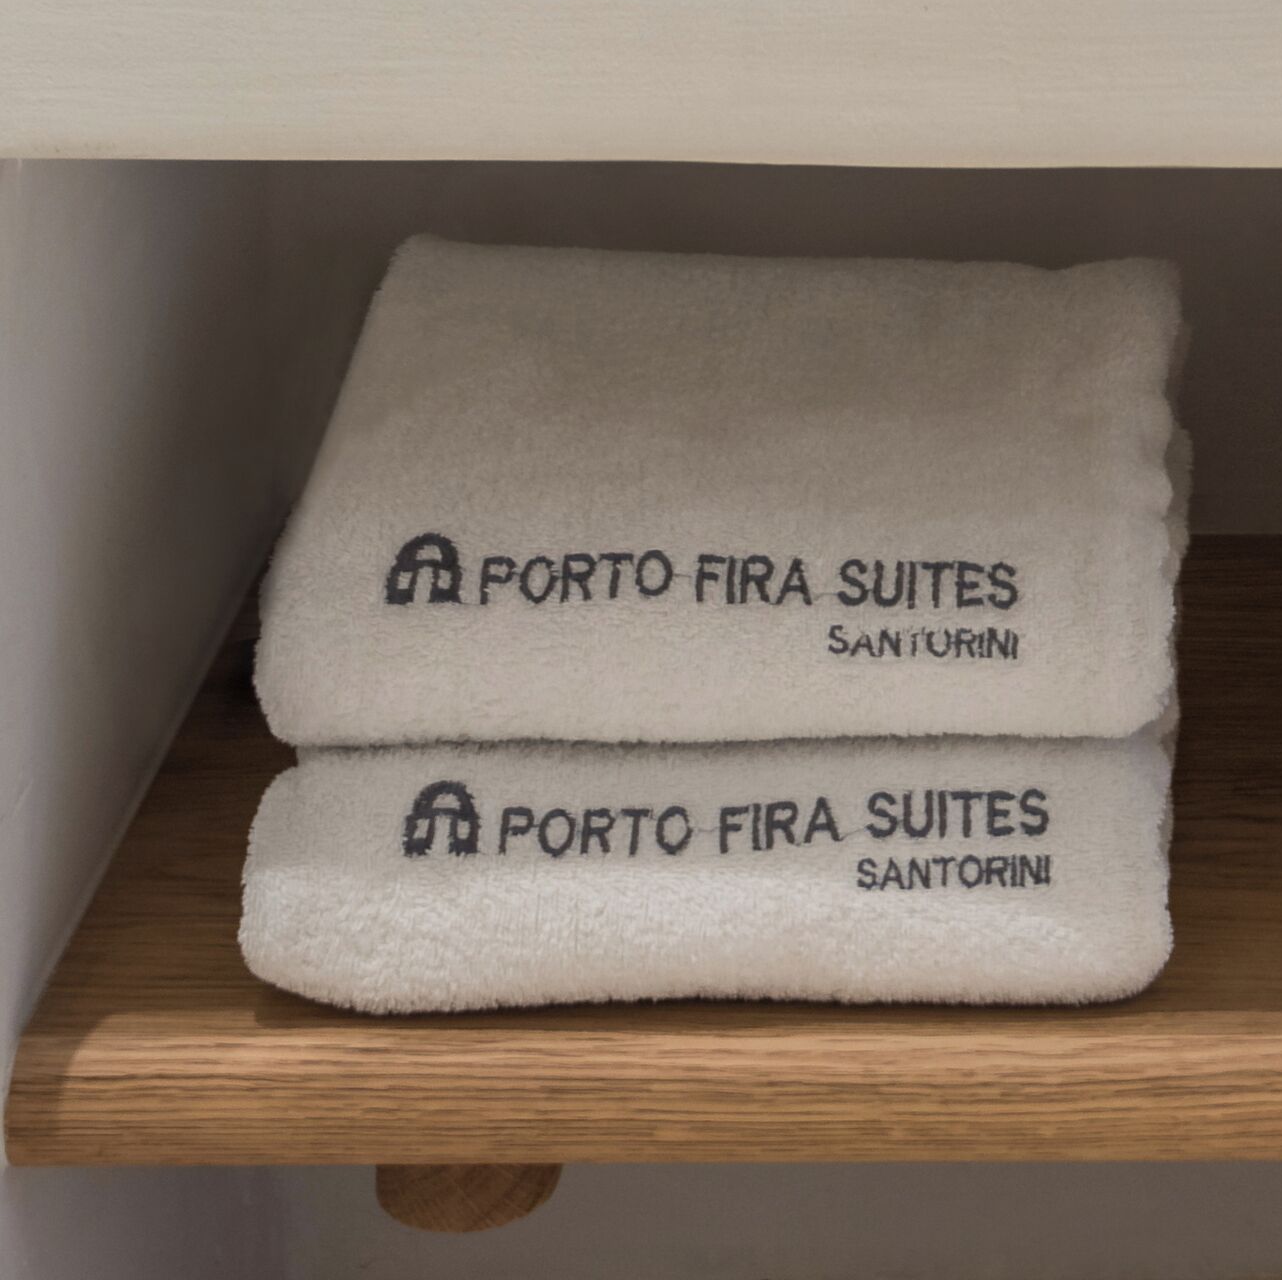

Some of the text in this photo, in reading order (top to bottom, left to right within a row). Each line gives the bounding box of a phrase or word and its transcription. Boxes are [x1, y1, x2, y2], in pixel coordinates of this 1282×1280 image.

[479, 549, 1019, 610] PORTO FIRA SUITES
[828, 623, 1020, 660] SANTORINI
[500, 789, 1051, 857] PORTO FIRA SUITES
[856, 854, 1051, 890] SANTORINI
